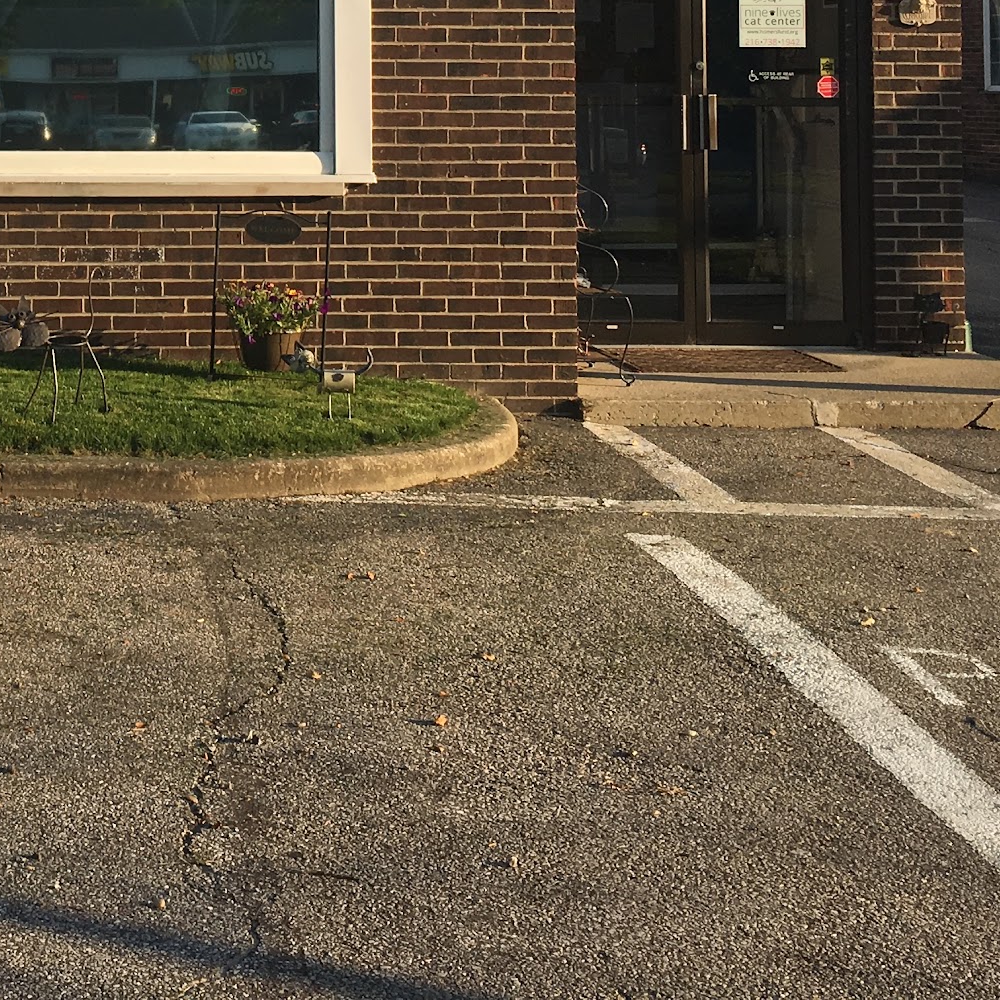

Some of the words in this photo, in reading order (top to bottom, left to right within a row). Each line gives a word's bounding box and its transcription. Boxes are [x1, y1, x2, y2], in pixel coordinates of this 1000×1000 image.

[744, 8, 768, 18] nine
[776, 7, 801, 18] lives
[744, 18, 761, 26] cat
[765, 18, 801, 26] center
